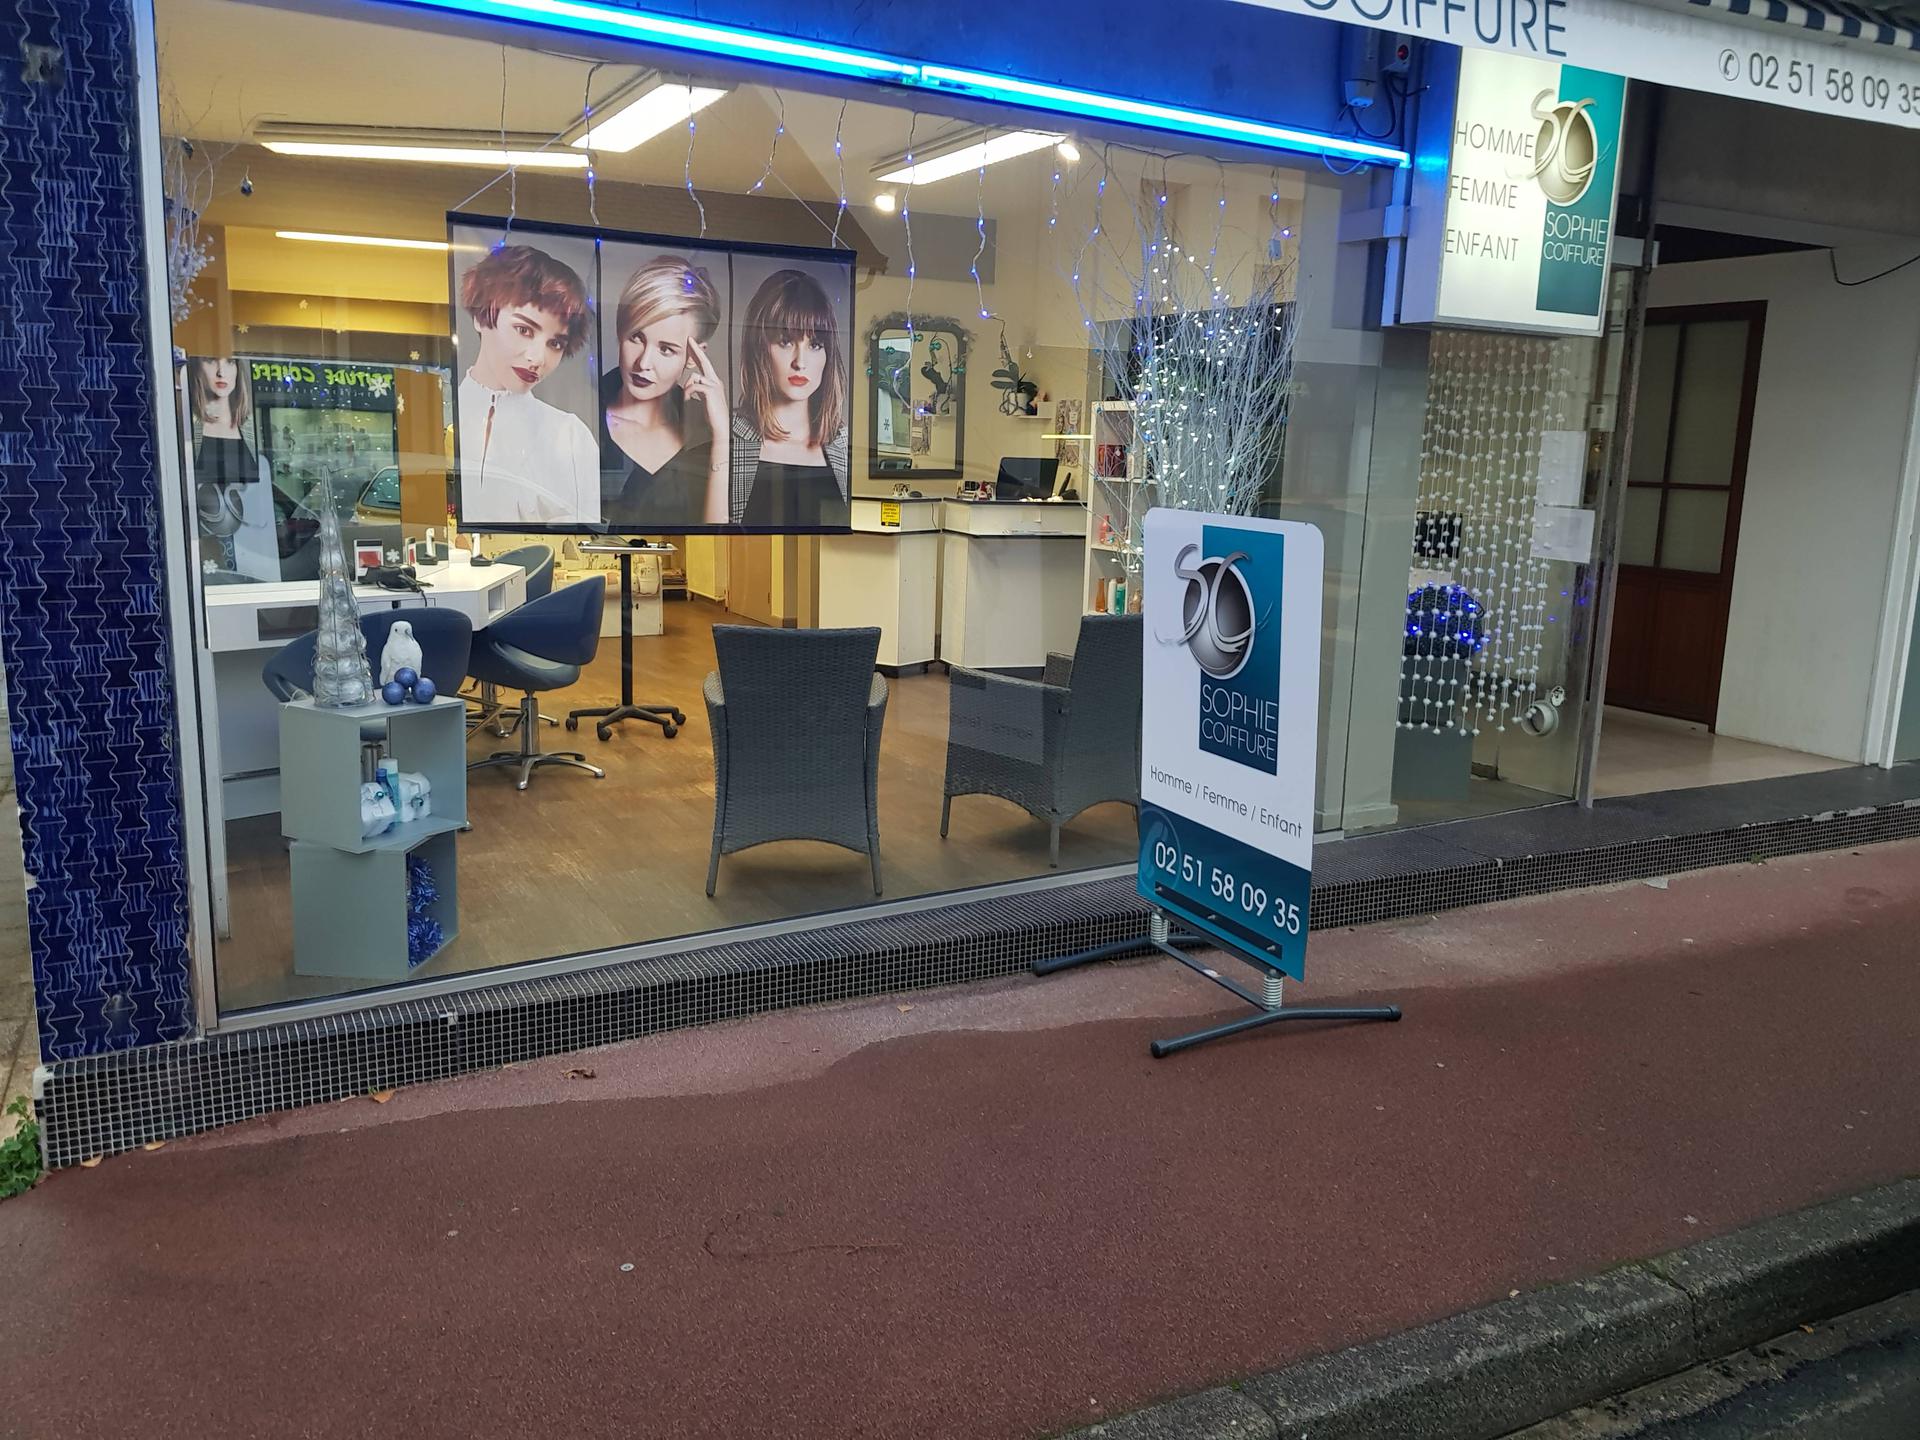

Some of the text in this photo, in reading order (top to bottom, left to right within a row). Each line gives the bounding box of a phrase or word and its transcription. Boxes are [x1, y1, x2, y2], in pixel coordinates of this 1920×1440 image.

[1749, 52, 1779, 90] 02
[1788, 60, 1814, 97] 51
[1825, 68, 1854, 103] 58
[1862, 76, 1890, 110] 09
[1455, 120, 1535, 158] HOMME
[1449, 174, 1518, 209] FEMME
[1445, 228, 1519, 261] ENFANT
[1545, 211, 1609, 245] SOPHIE
[1543, 241, 1605, 267] COIFFURE
[1201, 684, 1278, 734] SOPHIE
[1201, 718, 1276, 762] COIFFURE
[1150, 765, 1192, 794] Homme
[1203, 786, 1248, 816] Femme
[1260, 808, 1302, 838] Enfant
[1155, 842, 1300, 935] 02 51 58 09 35
